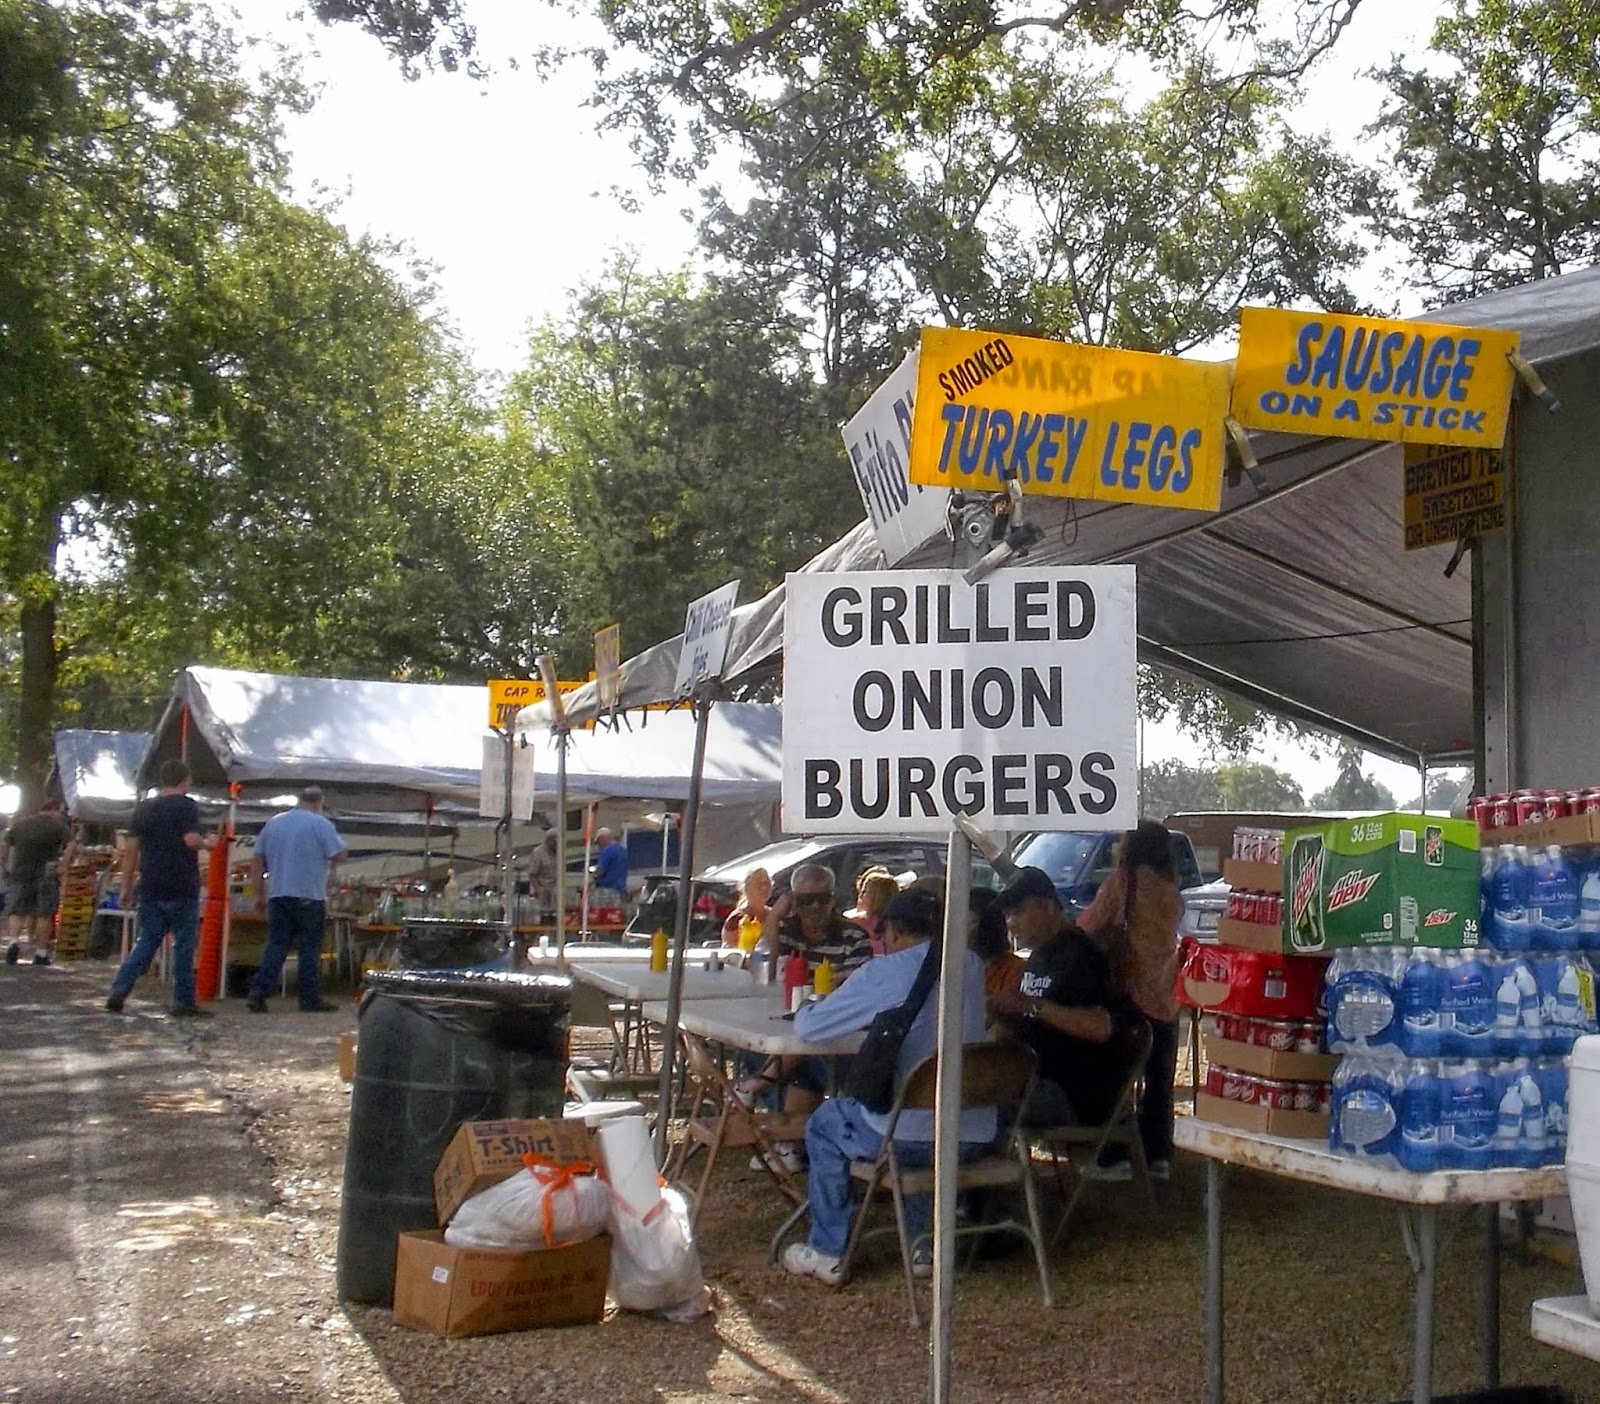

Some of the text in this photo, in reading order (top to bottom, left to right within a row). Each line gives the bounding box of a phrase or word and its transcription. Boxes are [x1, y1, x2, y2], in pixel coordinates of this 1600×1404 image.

[938, 338, 1014, 401] SMOKED
[1286, 322, 1481, 401] SAUSAGE
[1259, 391, 1488, 433] ON A STICK
[851, 427, 908, 530] Frito
[939, 403, 1201, 492] TURKEY LEGS
[821, 580, 1096, 648] GRILLED
[504, 687, 528, 697] CAP
[852, 666, 1063, 732] ONION
[804, 752, 1118, 820] BURGERS
[1351, 824, 1365, 842] 36
[1464, 918, 1478, 932] 36
[477, 1135, 555, 1157] T-Shirt
